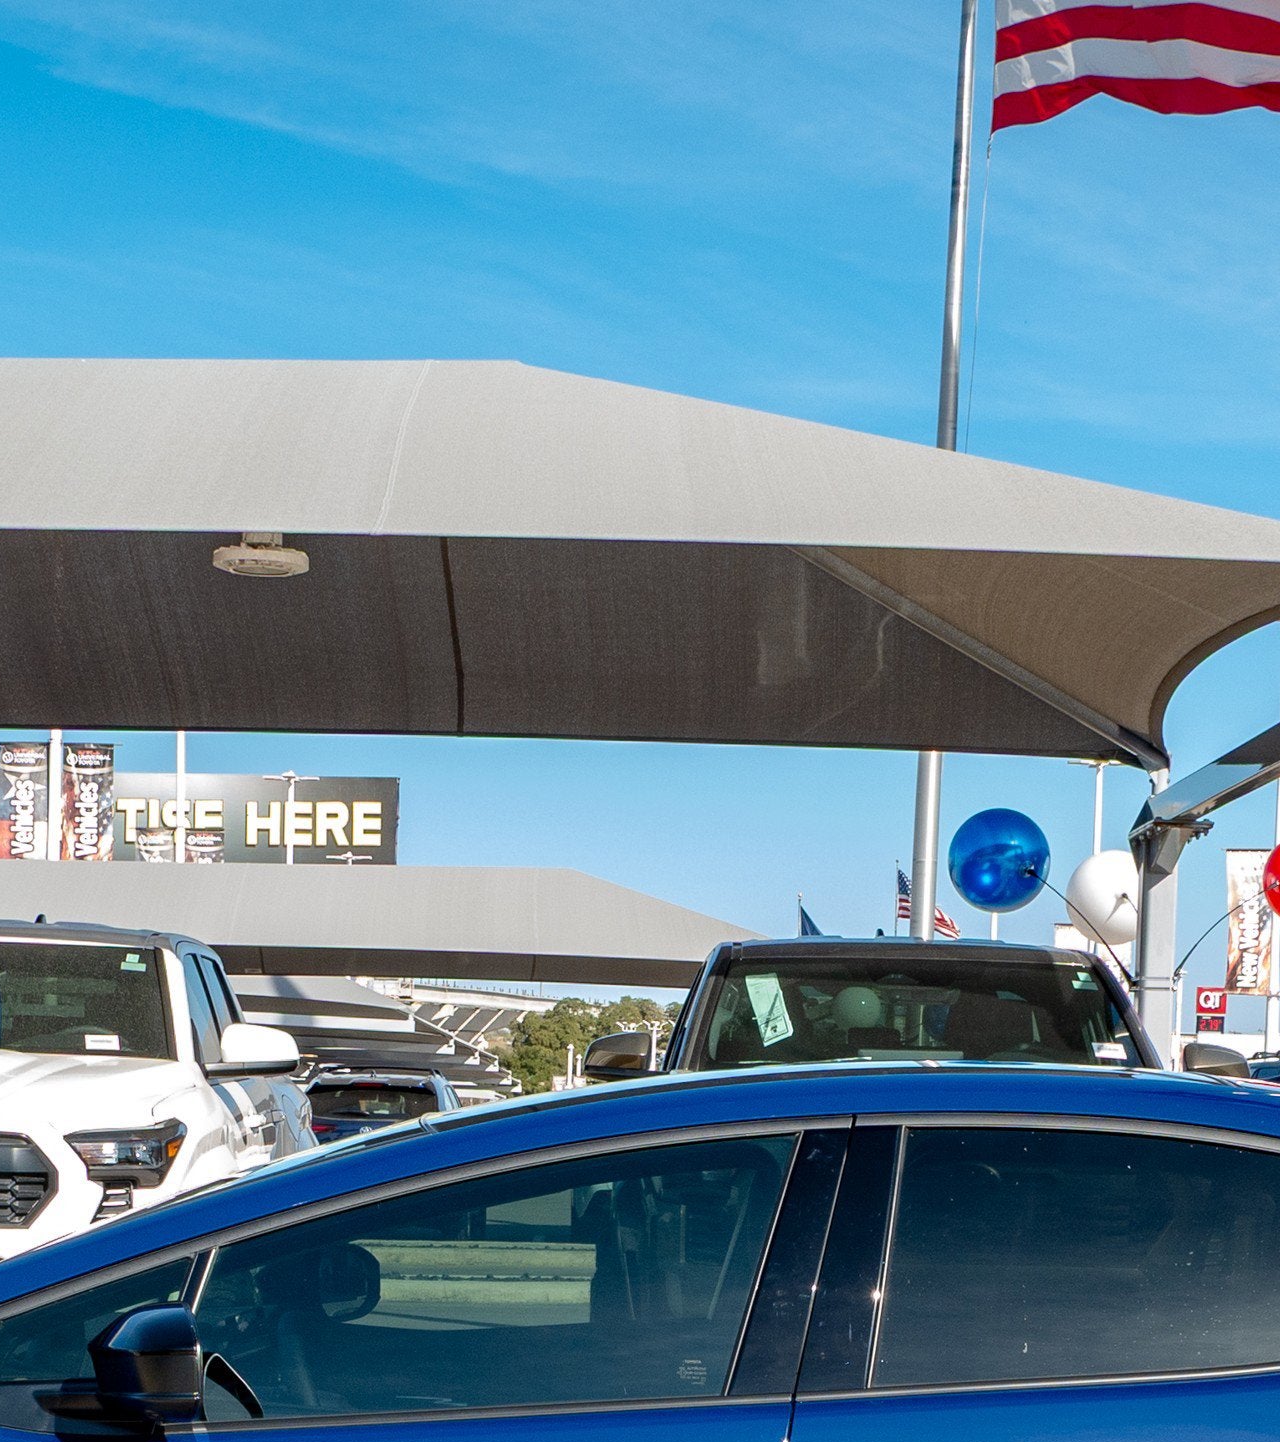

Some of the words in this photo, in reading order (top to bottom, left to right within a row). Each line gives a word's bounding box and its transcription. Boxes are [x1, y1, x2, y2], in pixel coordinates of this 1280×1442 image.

[9, 779, 36, 856] Vehicles
[74, 792, 100, 858] Vehicles
[245, 800, 383, 847] HERE
[1236, 952, 1259, 988] New
[1199, 991, 1224, 1010] QT
